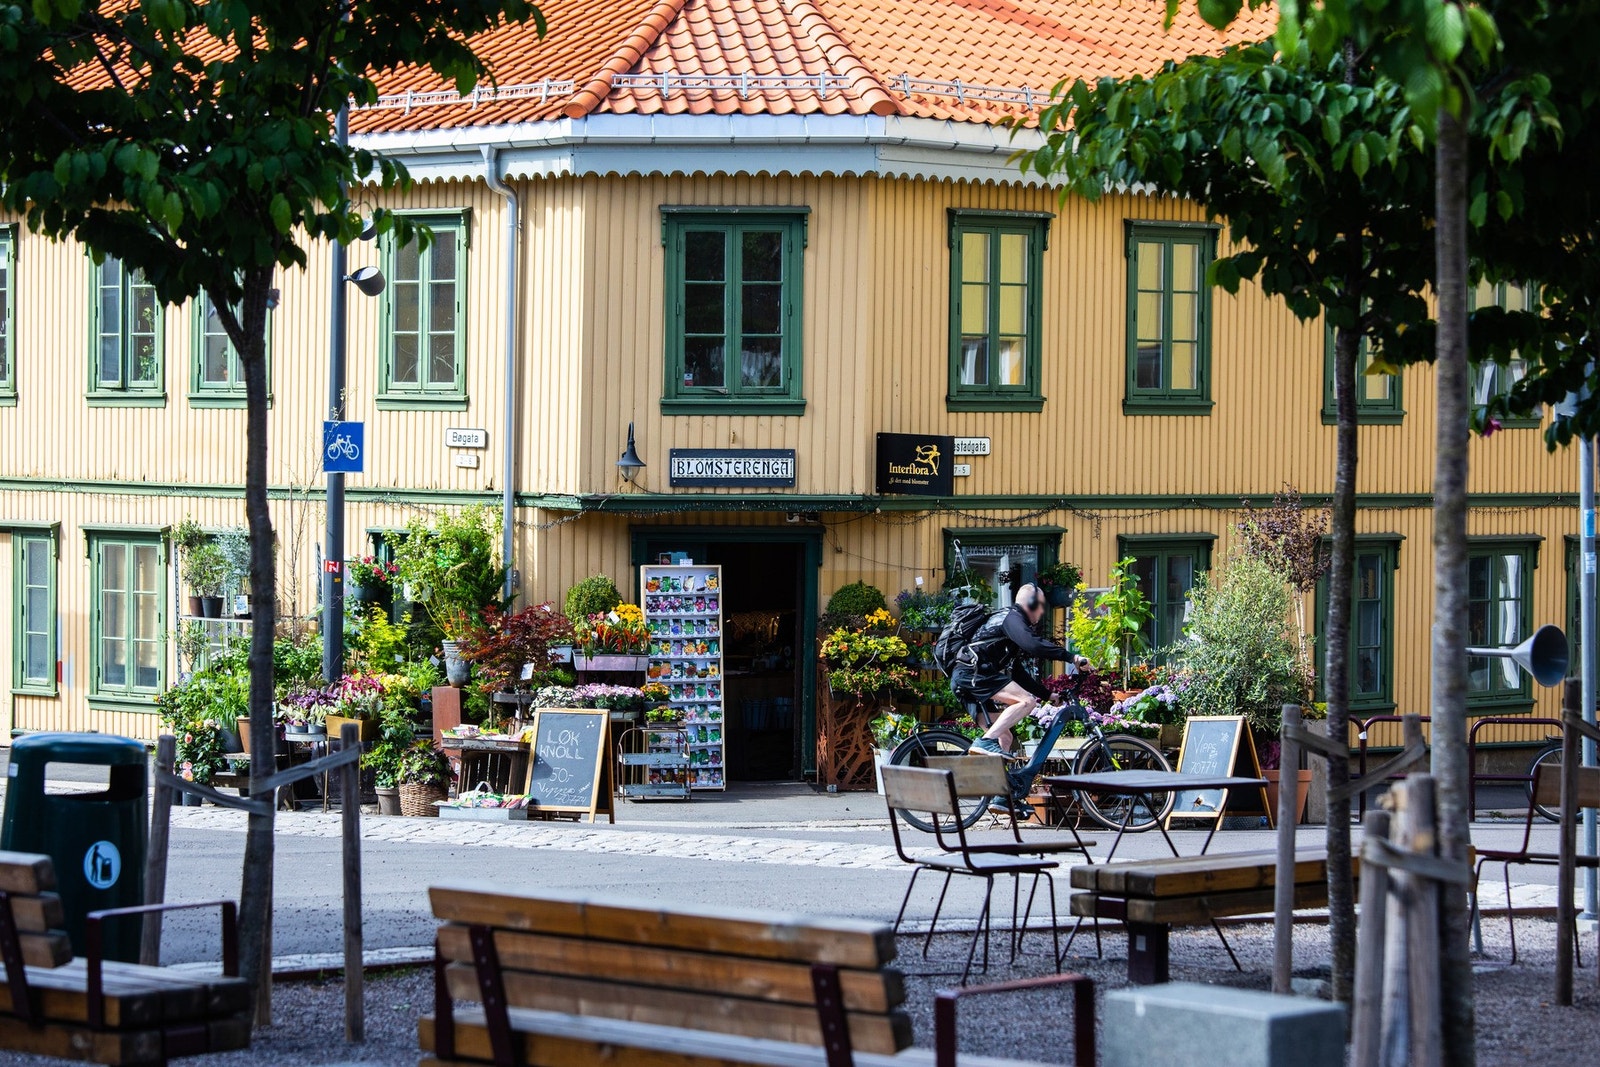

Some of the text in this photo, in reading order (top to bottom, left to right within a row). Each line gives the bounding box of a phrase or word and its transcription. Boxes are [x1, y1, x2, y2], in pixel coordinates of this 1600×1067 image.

[452, 431, 479, 446] Bøgata
[676, 460, 789, 475] BLOMSTERENGA
[888, 462, 930, 476] Interflora
[546, 729, 580, 746] LØK
[540, 745, 585, 760] KNOLL
